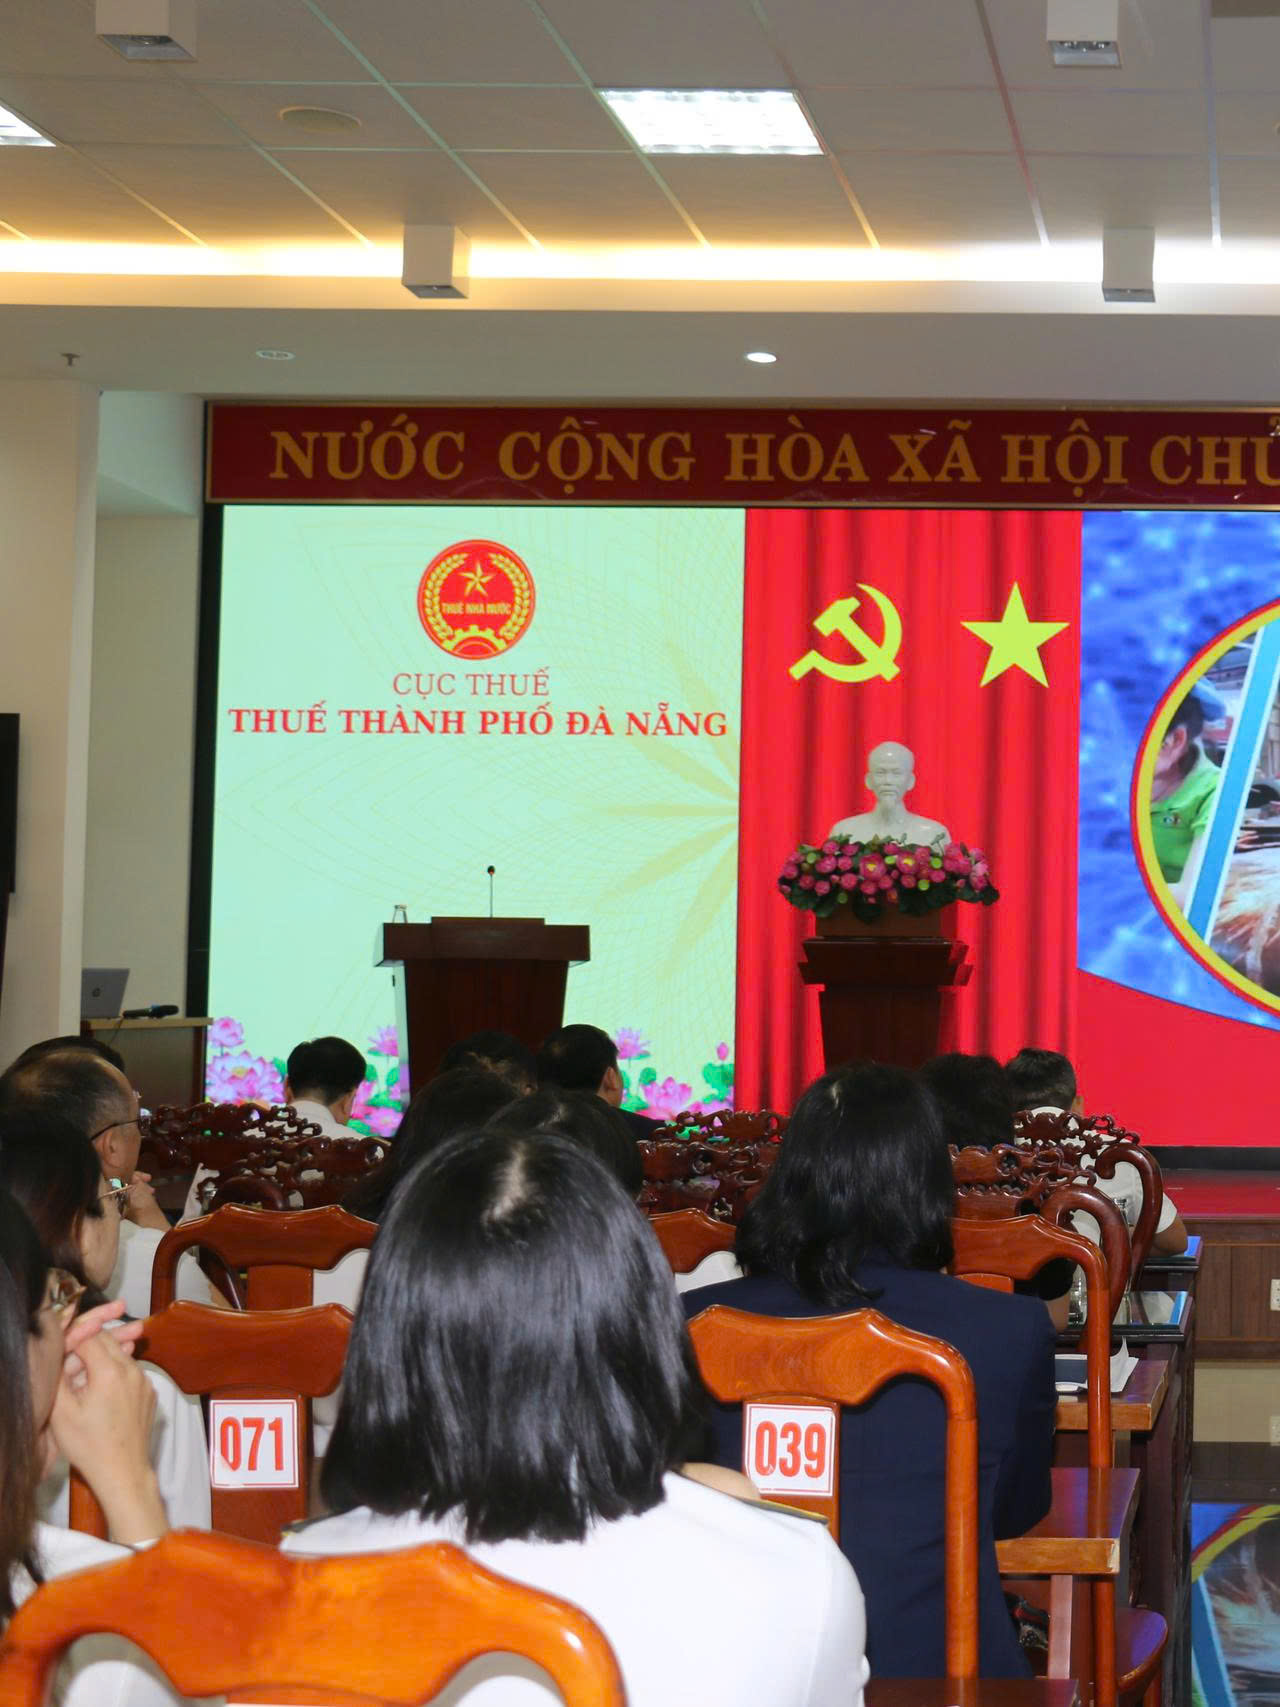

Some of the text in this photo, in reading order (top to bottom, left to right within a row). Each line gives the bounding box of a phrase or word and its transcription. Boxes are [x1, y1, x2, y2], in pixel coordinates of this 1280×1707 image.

[269, 415, 466, 481] NƯỚC
[500, 416, 696, 494] CỘNG
[724, 415, 869, 482] HÒA
[889, 420, 982, 483] XÃ
[1000, 418, 1129, 497] HỘI
[392, 666, 551, 701] CỤC THUẾ
[228, 700, 728, 737] THUẾ THÀNH PHỐ ĐÀ NẴNG
[220, 1417, 284, 1471] 071
[755, 1420, 827, 1479] 039
